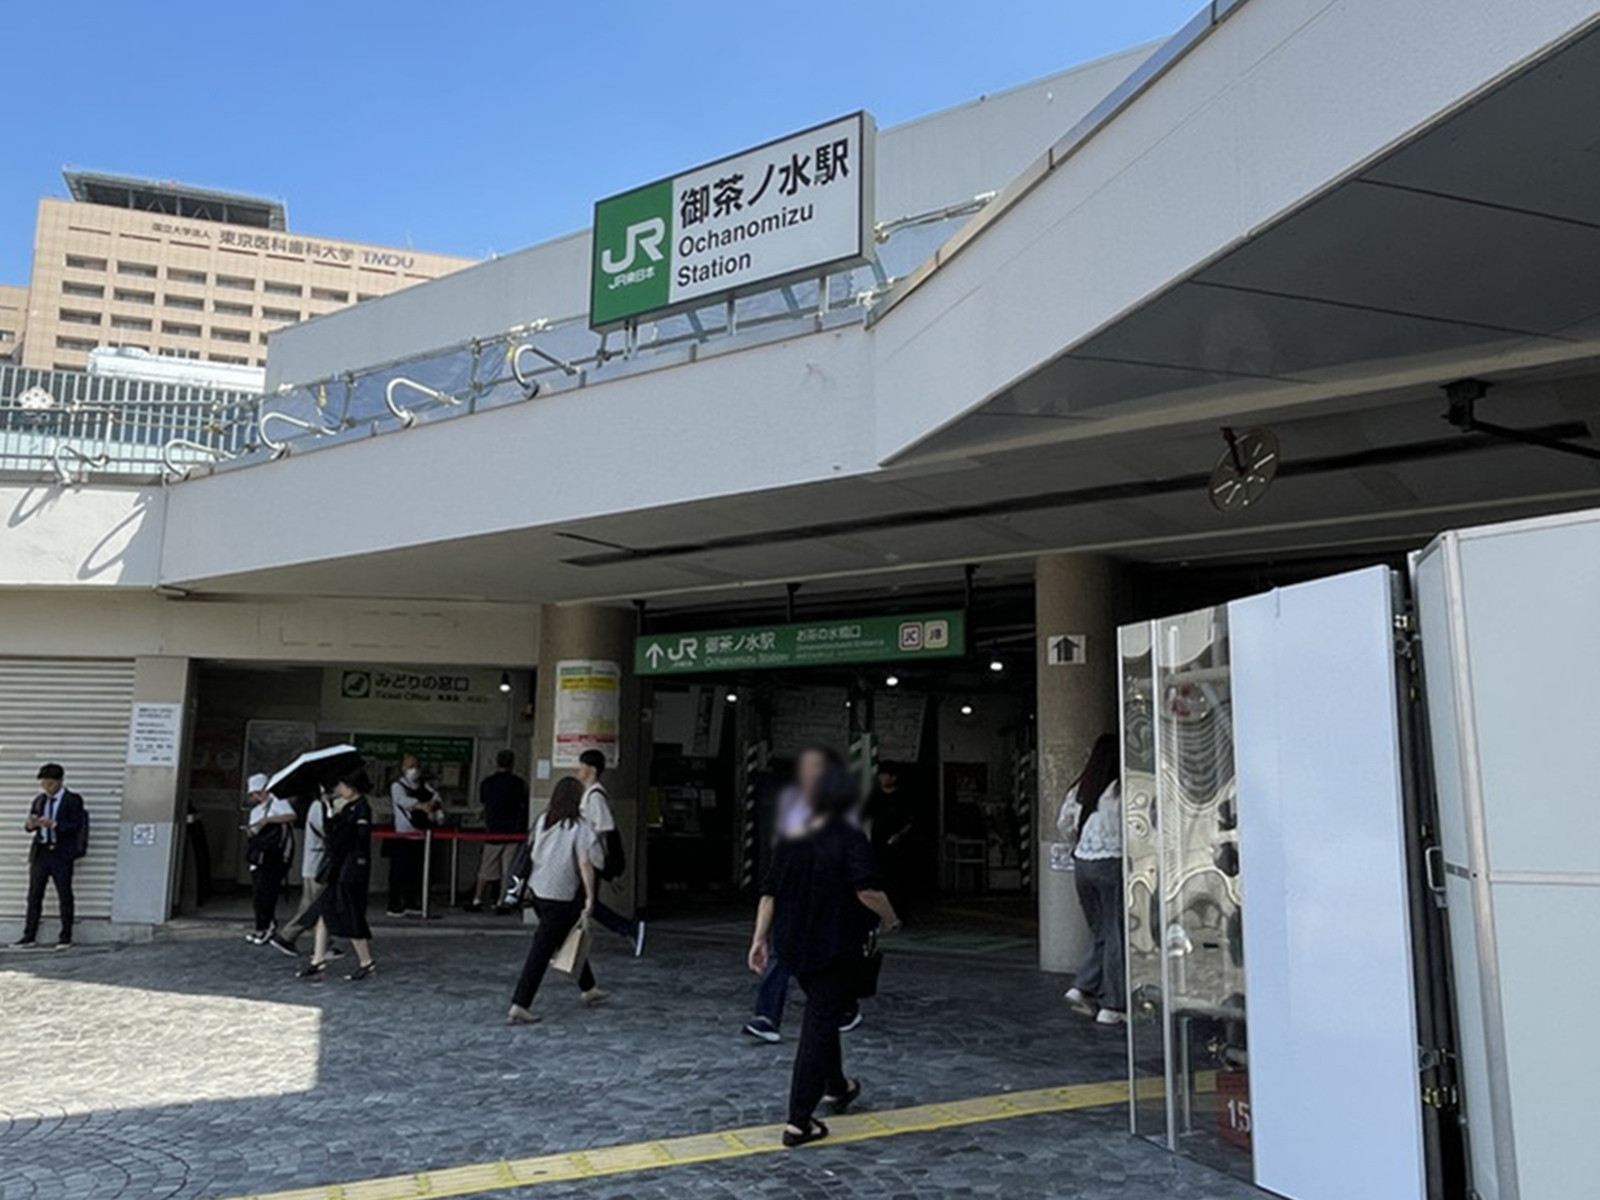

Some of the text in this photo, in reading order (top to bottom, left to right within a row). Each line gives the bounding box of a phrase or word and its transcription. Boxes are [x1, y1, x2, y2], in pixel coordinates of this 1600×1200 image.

[680, 138, 849, 229] 御茶ノ水駅
[601, 217, 666, 275] JR
[679, 204, 814, 258] Ochanomizu
[219, 230, 355, 262] 東京医科歯科大学
[361, 251, 415, 270] TMDU
[608, 267, 655, 290] JR東日本
[677, 253, 751, 288] Station
[667, 638, 698, 661] JR
[704, 631, 776, 654] 御茶ノ水駅
[374, 672, 470, 692] みどりの窓口
